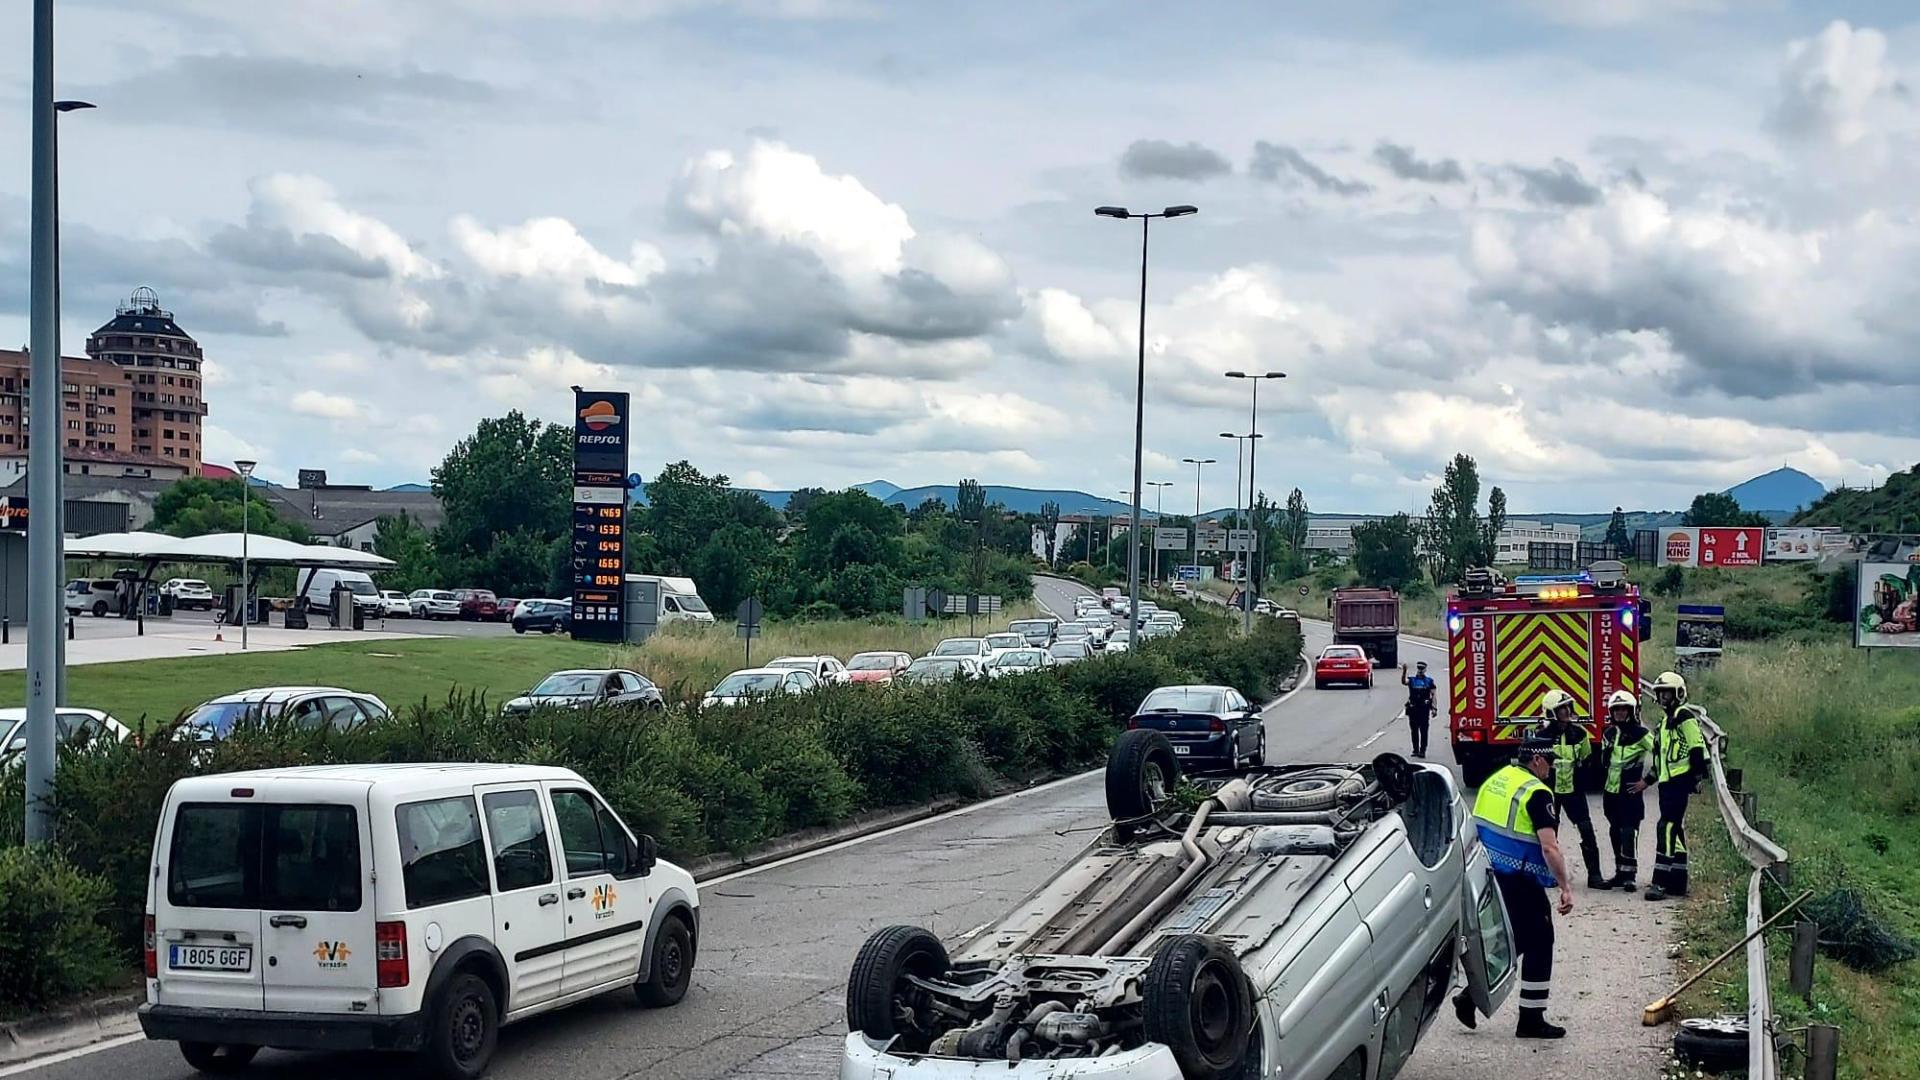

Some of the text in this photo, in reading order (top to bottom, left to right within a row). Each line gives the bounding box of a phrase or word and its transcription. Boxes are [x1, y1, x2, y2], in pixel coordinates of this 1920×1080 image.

[579, 435, 621, 444] REPSOL
[1666, 548, 1690, 557] KING
[1472, 618, 1487, 709] BOMBEROS
[1468, 718, 1483, 727] 112
[183, 949, 247, 966] 1805 GGF
